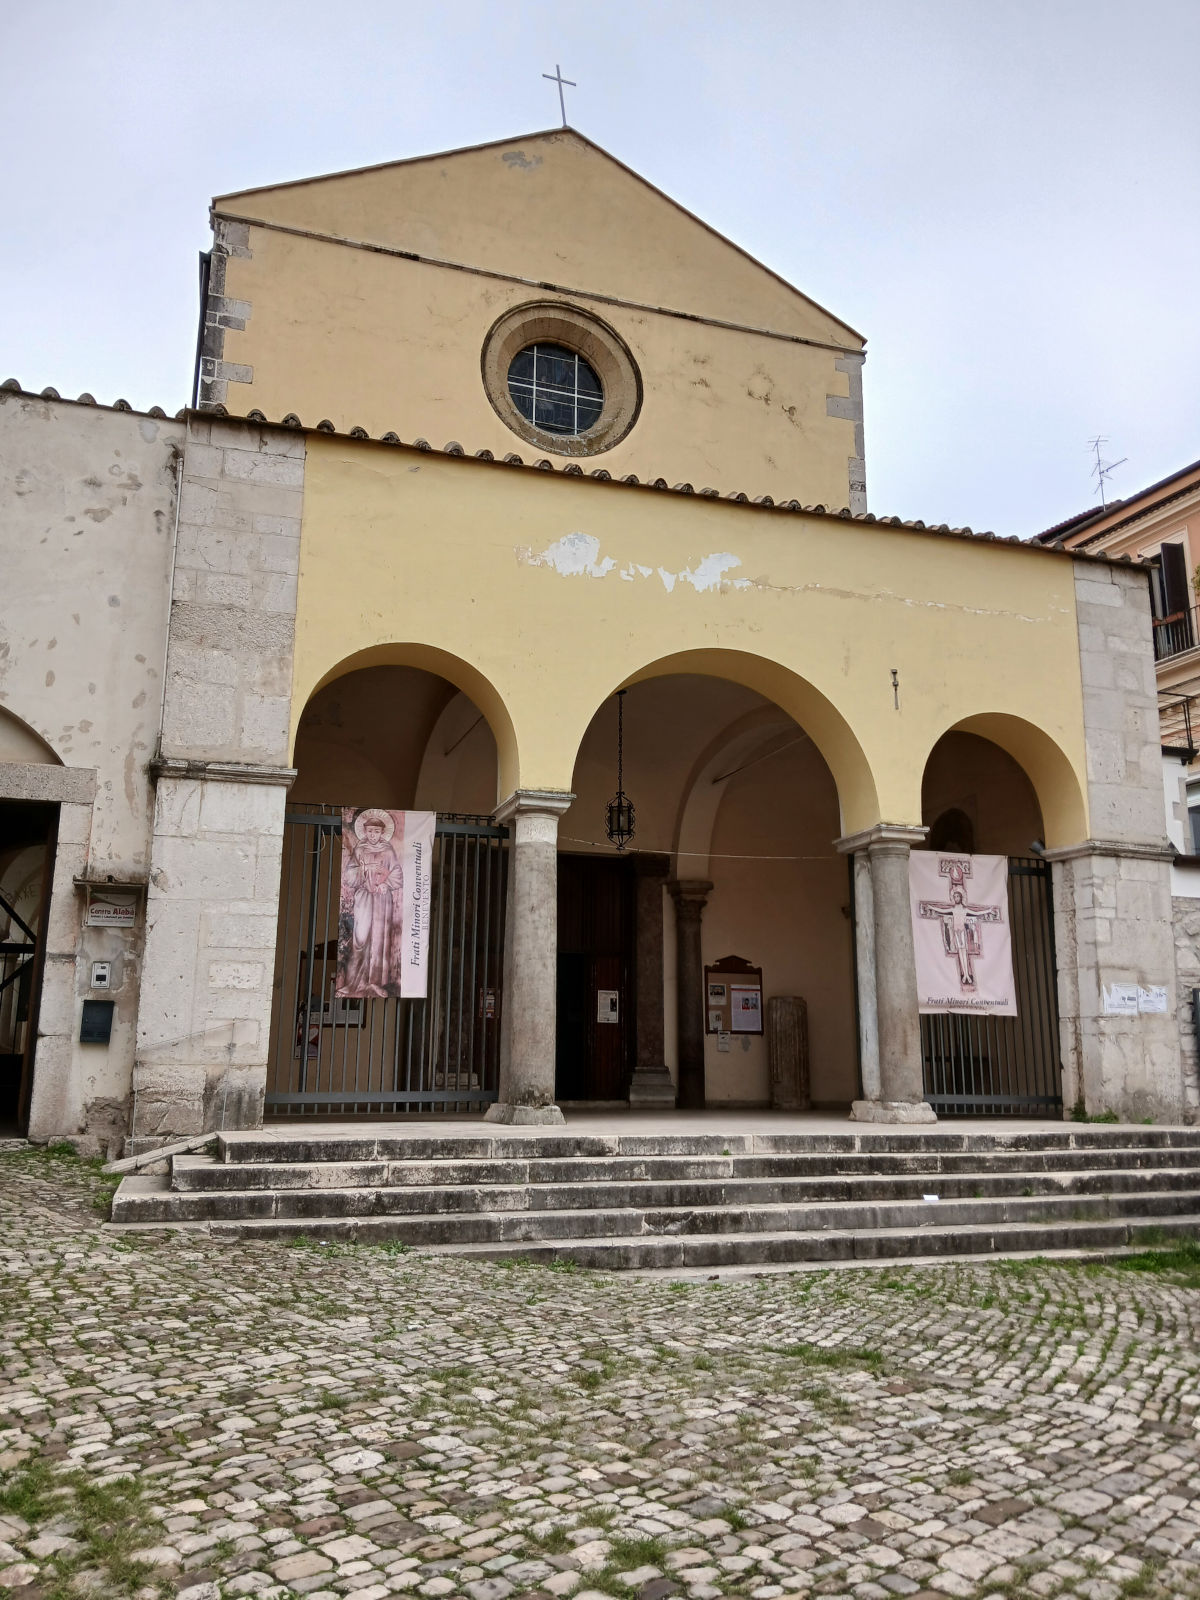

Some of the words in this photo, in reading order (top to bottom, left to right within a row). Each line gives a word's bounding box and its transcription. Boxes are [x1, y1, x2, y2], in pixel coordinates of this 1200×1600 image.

[412, 841, 422, 901] Conventuali
[90, 907, 112, 915] Centro
[421, 874, 430, 931] BENEVENTO
[411, 903, 421, 940] Minori
[410, 941, 420, 967] Frati
[927, 996, 944, 1005] Frati
[946, 997, 969, 1006] Minori
[971, 998, 1009, 1006] Conventuali
